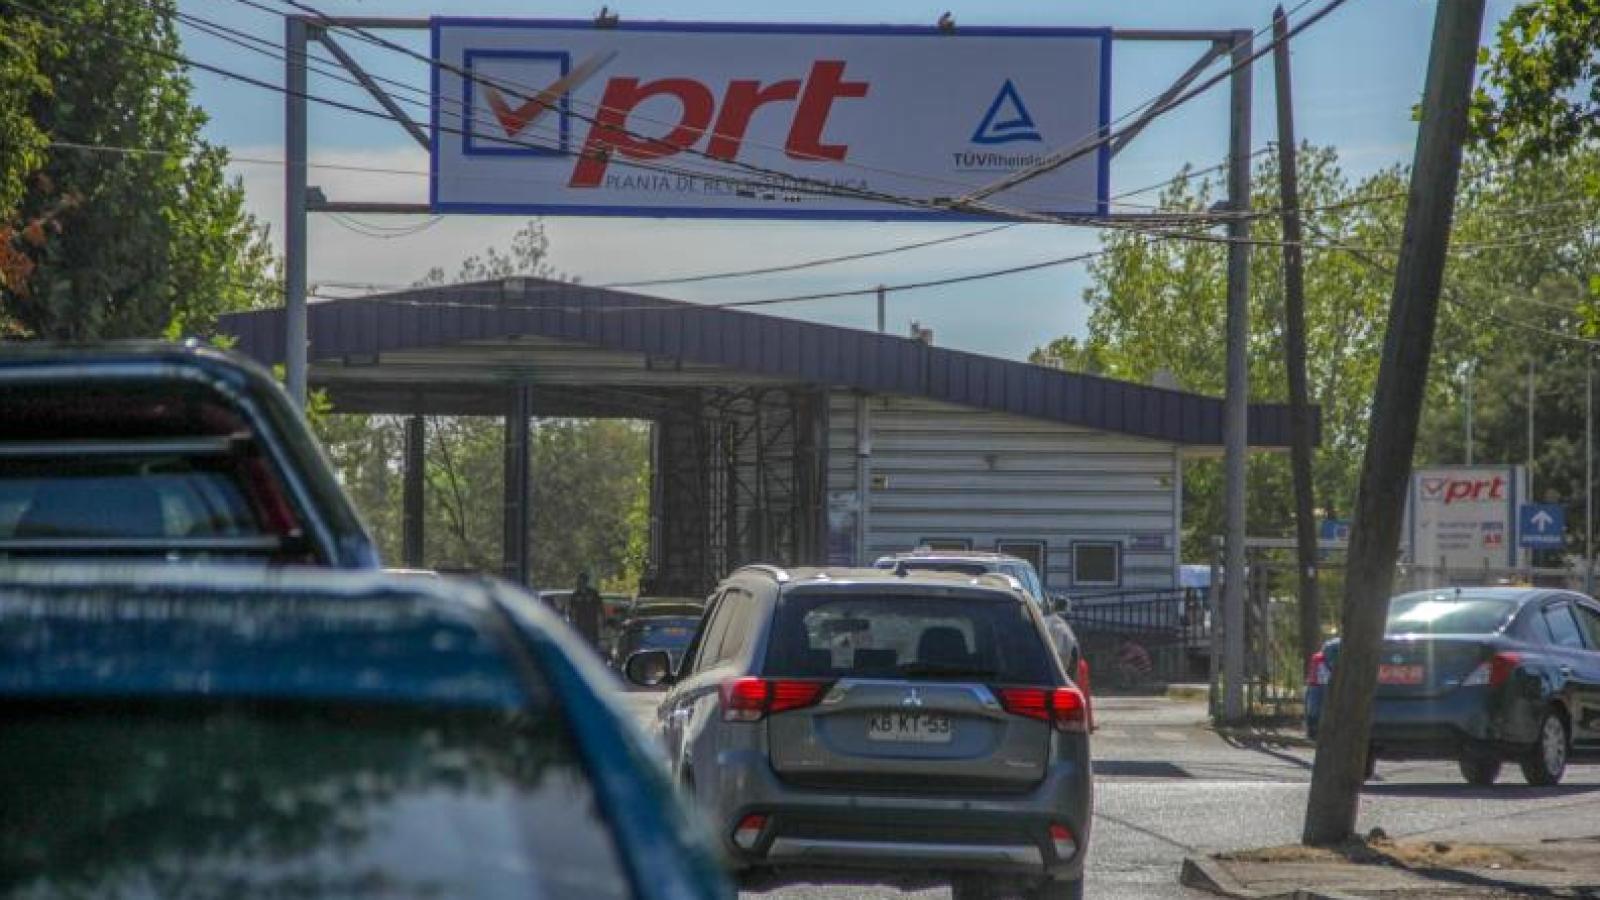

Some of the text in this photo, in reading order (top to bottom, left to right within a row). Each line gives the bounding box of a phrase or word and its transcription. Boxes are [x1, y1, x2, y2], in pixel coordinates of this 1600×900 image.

[566, 59, 870, 189] prt
[606, 174, 672, 192] PLANTA
[677, 176, 699, 193] DE
[1444, 476, 1506, 505] prt
[869, 717, 893, 732] KB
